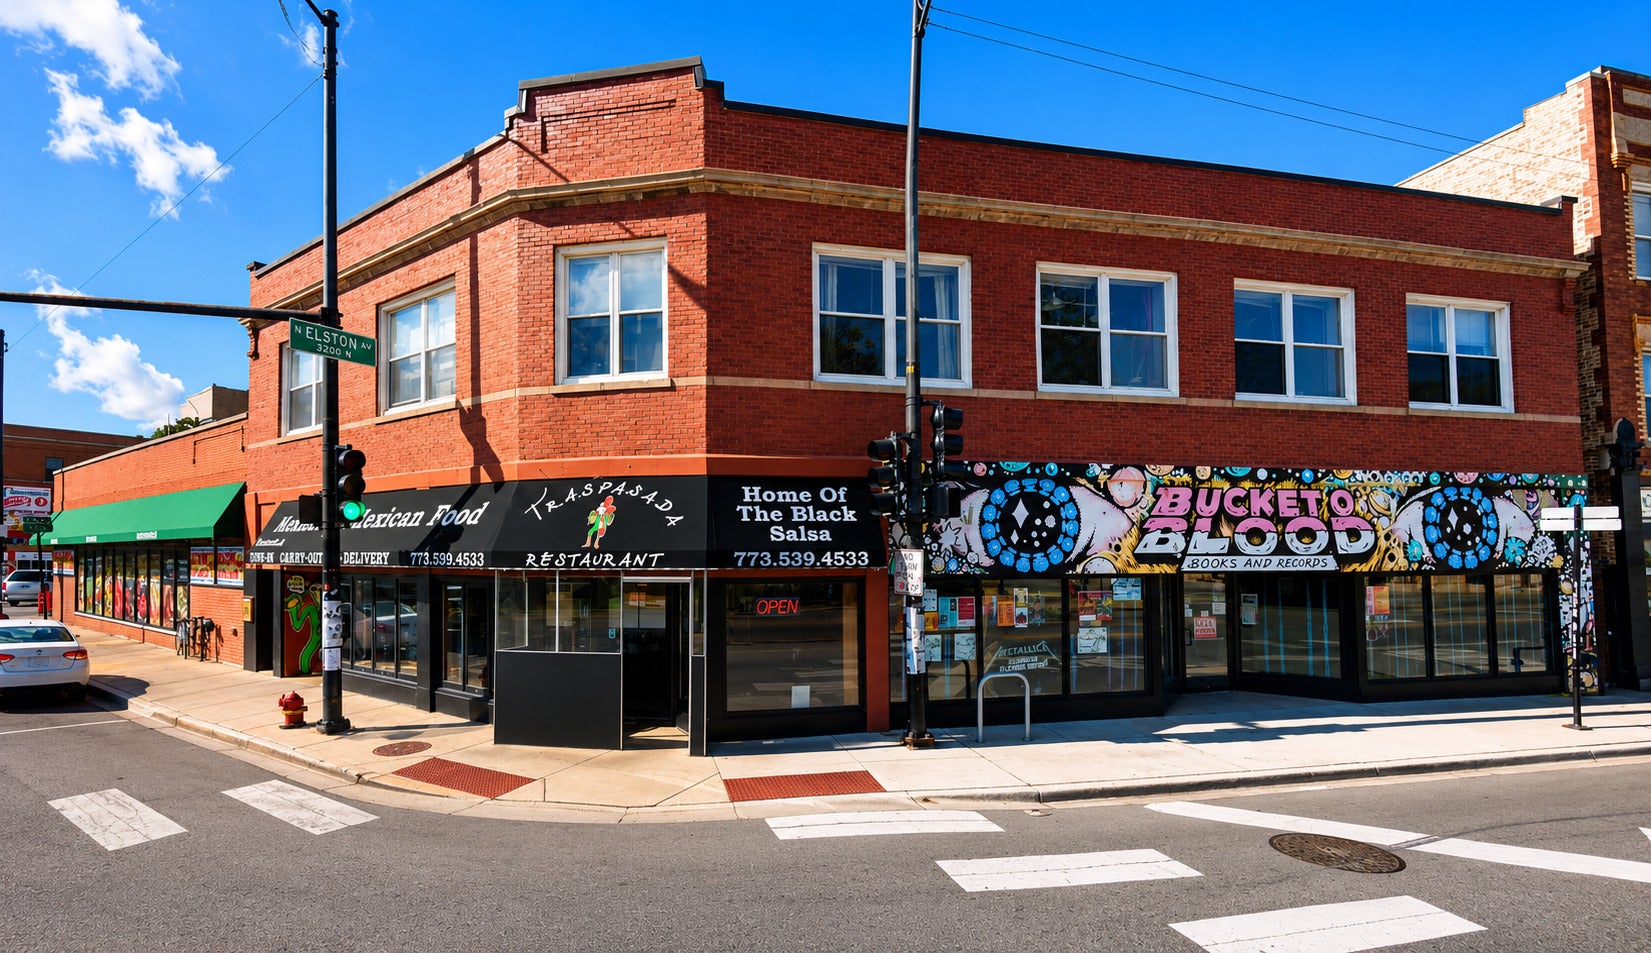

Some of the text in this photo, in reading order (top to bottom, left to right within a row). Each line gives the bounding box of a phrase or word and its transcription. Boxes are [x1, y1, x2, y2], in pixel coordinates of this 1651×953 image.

[295, 325, 372, 350] N ELSTON AV
[316, 343, 352, 359] 3200 N
[741, 486, 848, 503] Home Of
[1150, 487, 1323, 518] BUCKET
[425, 501, 491, 527] Food
[736, 505, 858, 522] The Black
[769, 525, 833, 542] Salsa
[1134, 516, 1376, 556] BLOOD
[279, 551, 324, 564] CARRY-OUT
[343, 551, 390, 565] DELIVERY
[410, 551, 485, 567] 773.599.4533
[525, 551, 665, 567] RESTAURANT
[733, 551, 869, 567] 773.539.4533
[1187, 557, 1329, 569] BOOKS AND RECORDS
[756, 599, 799, 615] OPEN
